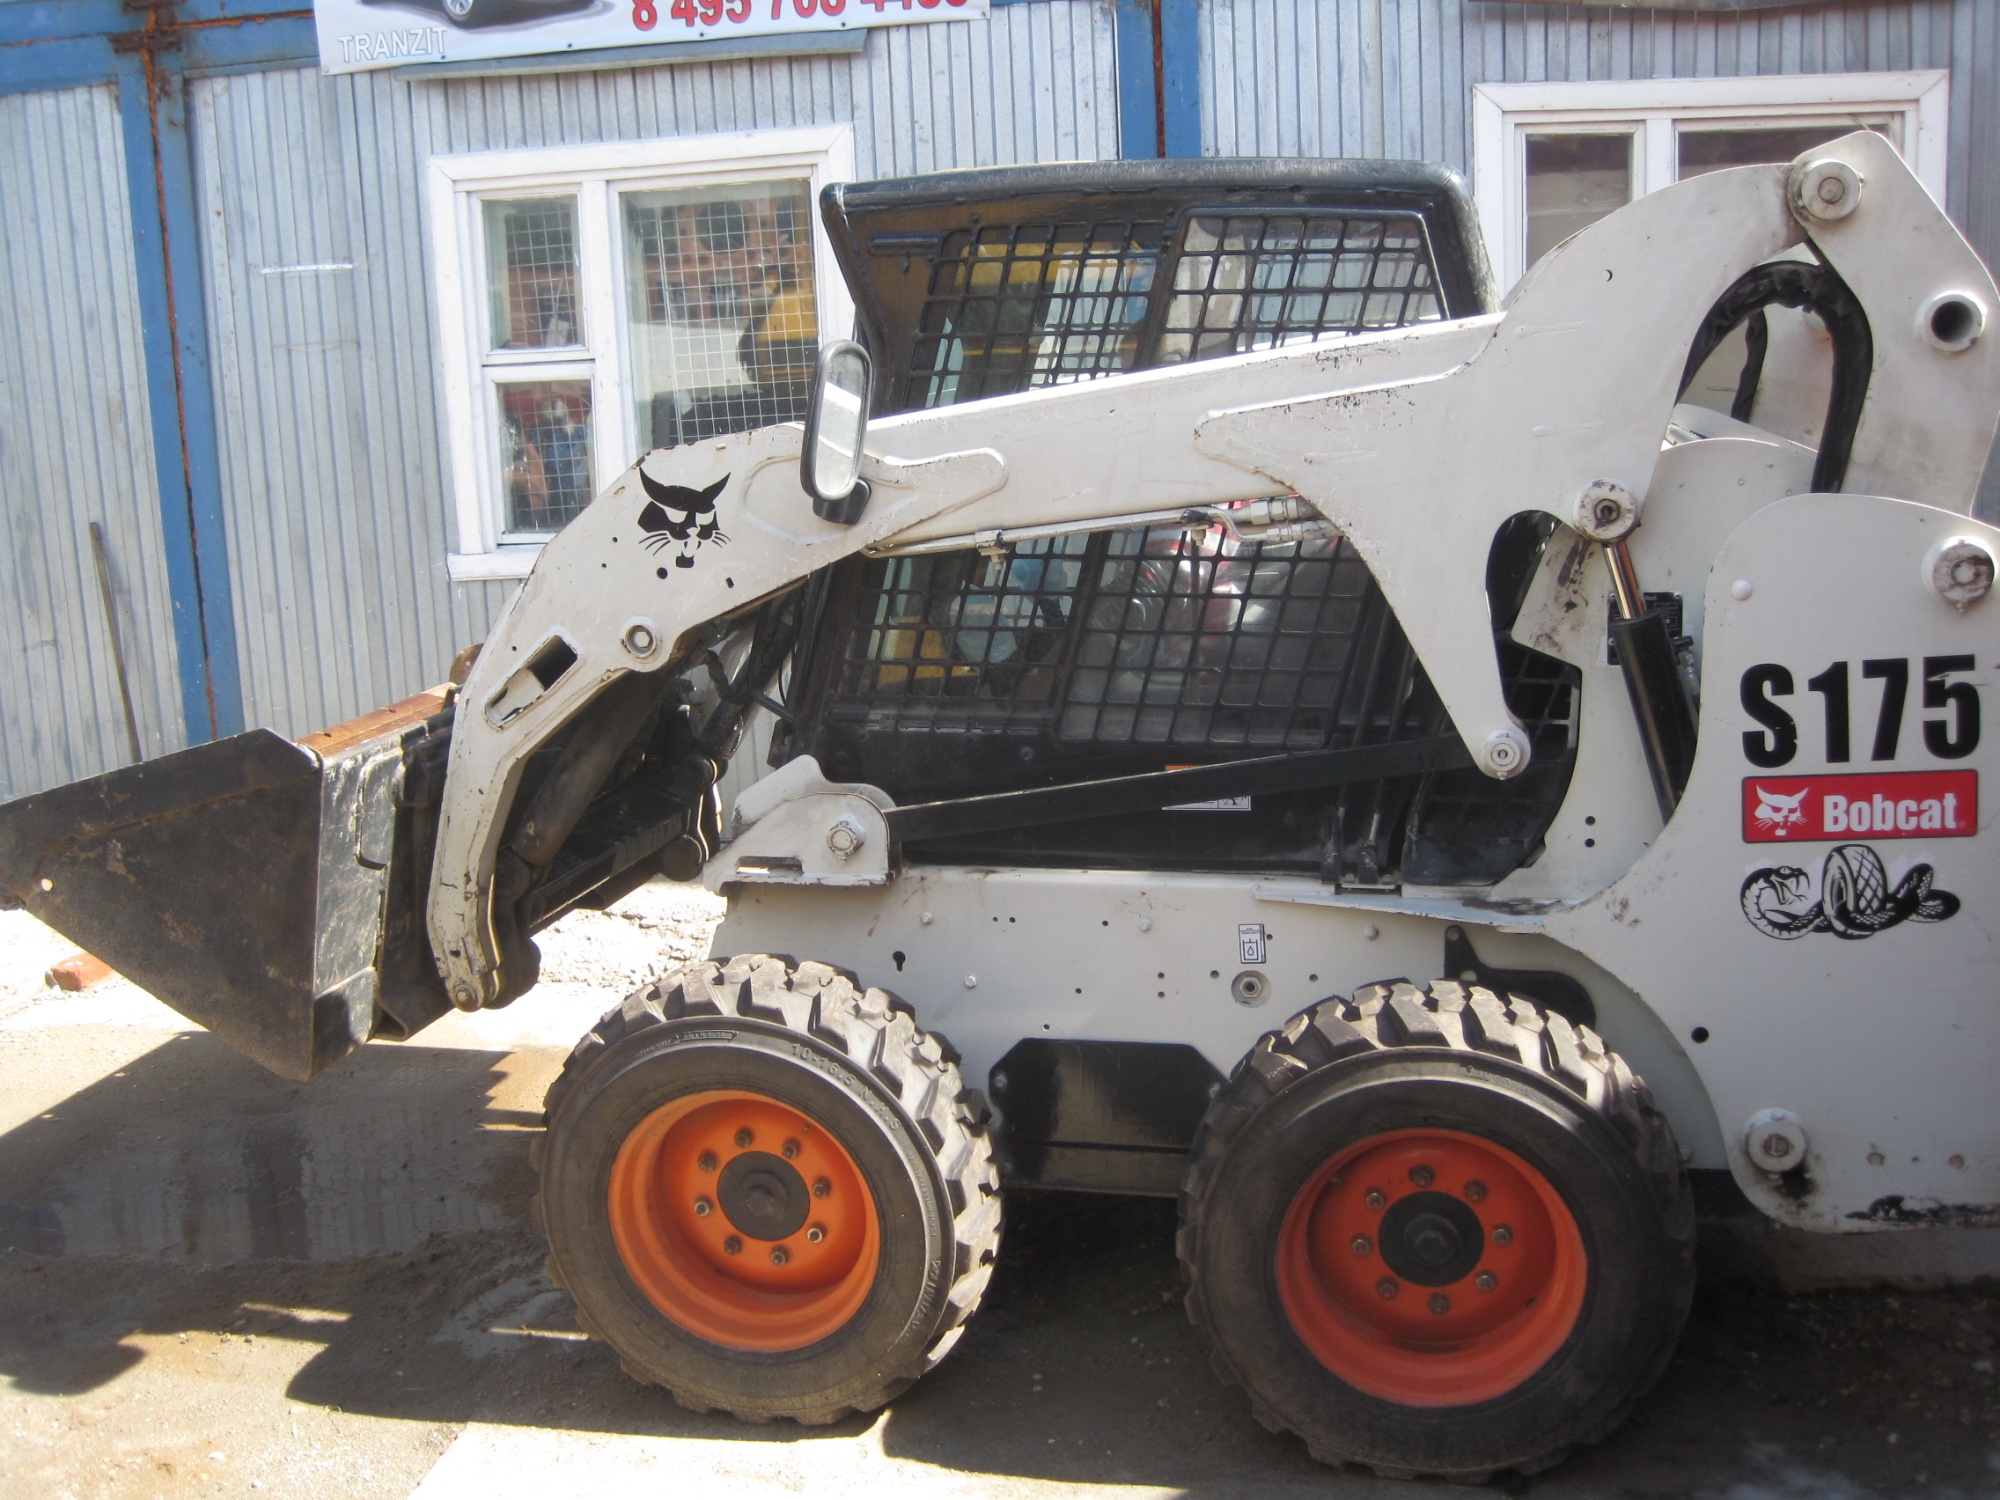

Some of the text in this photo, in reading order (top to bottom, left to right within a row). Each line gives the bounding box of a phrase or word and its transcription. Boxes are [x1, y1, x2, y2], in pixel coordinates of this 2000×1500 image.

[338, 26, 447, 63] TRANZIT
[1740, 654, 1980, 768] S175
[1823, 793, 1957, 833] Bobcat
